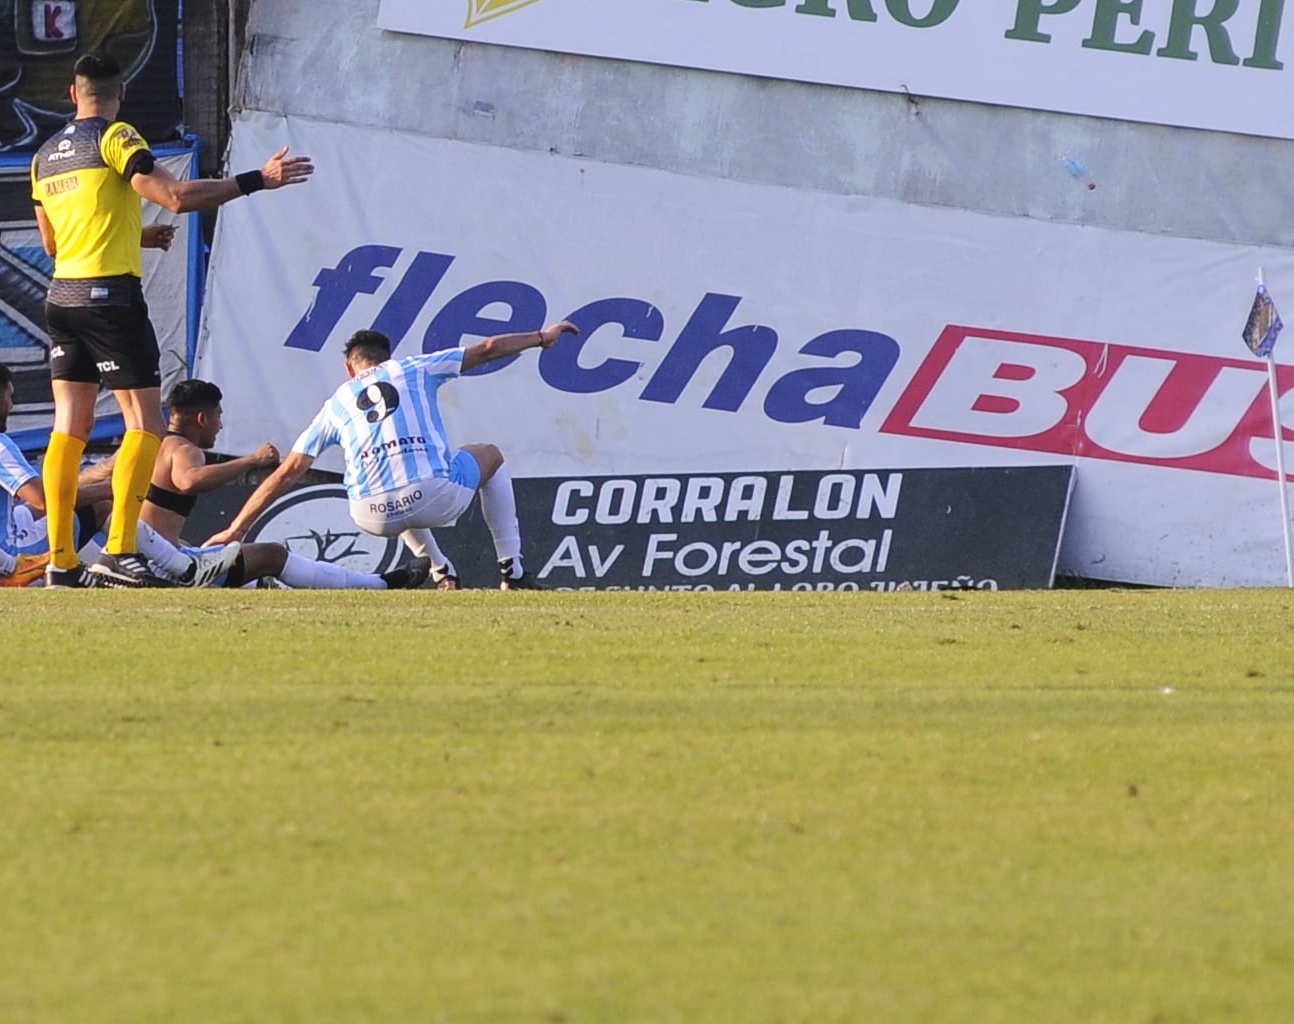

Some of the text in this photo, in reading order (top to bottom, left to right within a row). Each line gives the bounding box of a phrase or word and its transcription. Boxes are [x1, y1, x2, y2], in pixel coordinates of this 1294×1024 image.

[44, 3, 63, 40] K
[96, 360, 120, 373] TCL
[356, 381, 400, 423] 9
[370, 489, 423, 513] ROSARIO
[551, 472, 903, 526] CORRALON
[537, 528, 893, 579] Av Forestal
